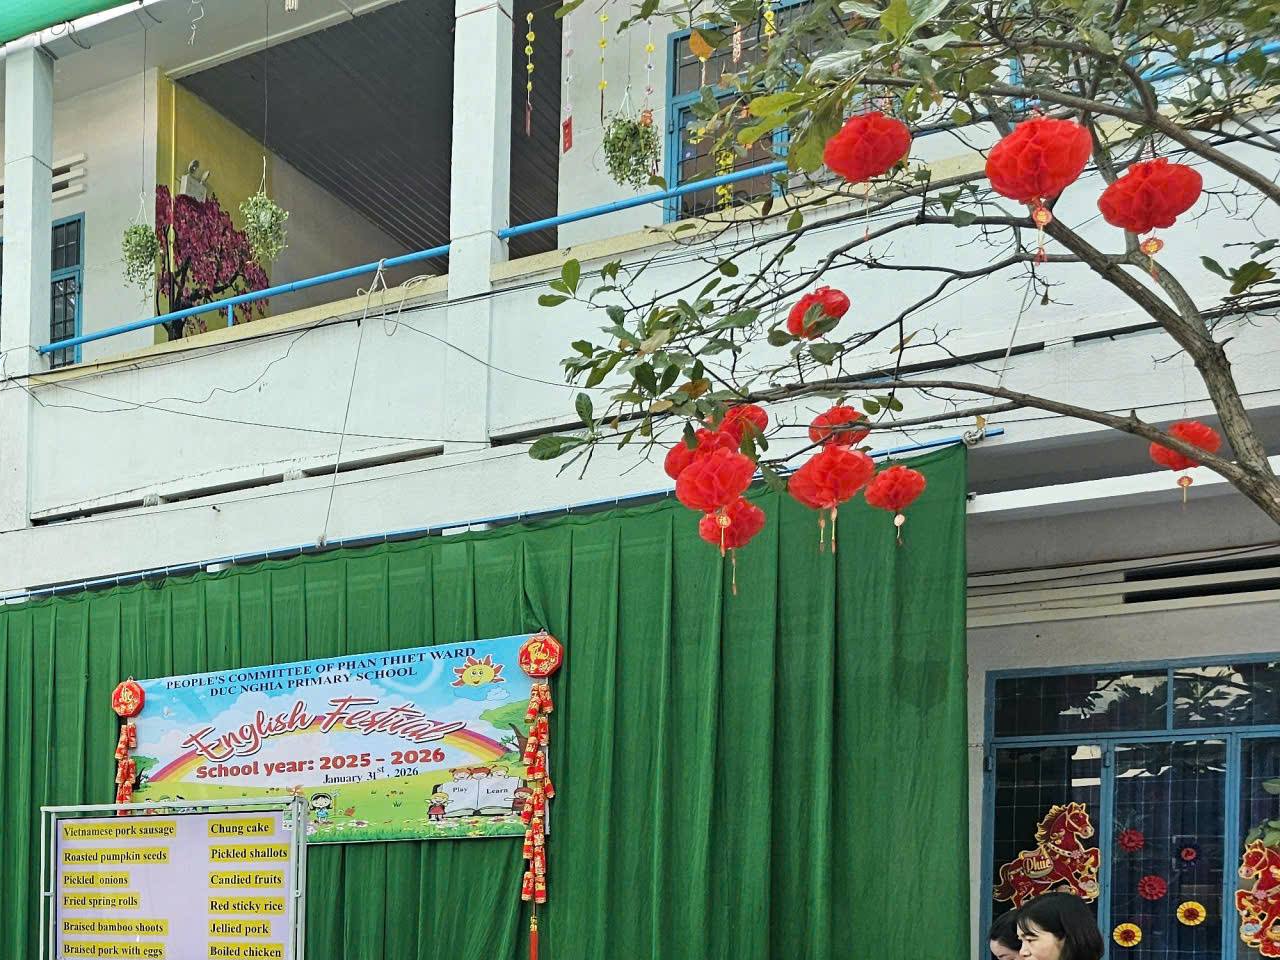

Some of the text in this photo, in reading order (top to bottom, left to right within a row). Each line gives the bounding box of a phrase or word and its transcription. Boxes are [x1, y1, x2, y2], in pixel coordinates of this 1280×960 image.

[166, 647, 476, 690] PEOPLE'S COMMITTEE OF PHAN THIET WARD
[210, 667, 418, 697] DUC NGHIA PRIMARY SCHOOL
[181, 700, 314, 760] English
[320, 696, 466, 743] Festival
[196, 760, 259, 779] School
[263, 759, 314, 778] year:
[319, 752, 371, 770] 2025
[390, 748, 445, 765] 2026
[322, 774, 363, 784] January
[63, 825, 174, 837] Vietnamese pork sausage
[210, 822, 269, 836] Chung cake
[64, 850, 167, 863] Roasted pumpkin seeds
[211, 847, 288, 859] Pickled shallots
[63, 875, 128, 885] Pickled onions
[210, 874, 282, 885] Candied fruits
[63, 896, 138, 908] Fried spring rolls
[210, 900, 283, 913] Red sticky rice
[63, 922, 164, 932] Braised bamboo shoots
[210, 923, 269, 937] Jellied pork
[63, 944, 163, 958] Braised pork with eggs
[210, 946, 282, 957] Boiled chicken
